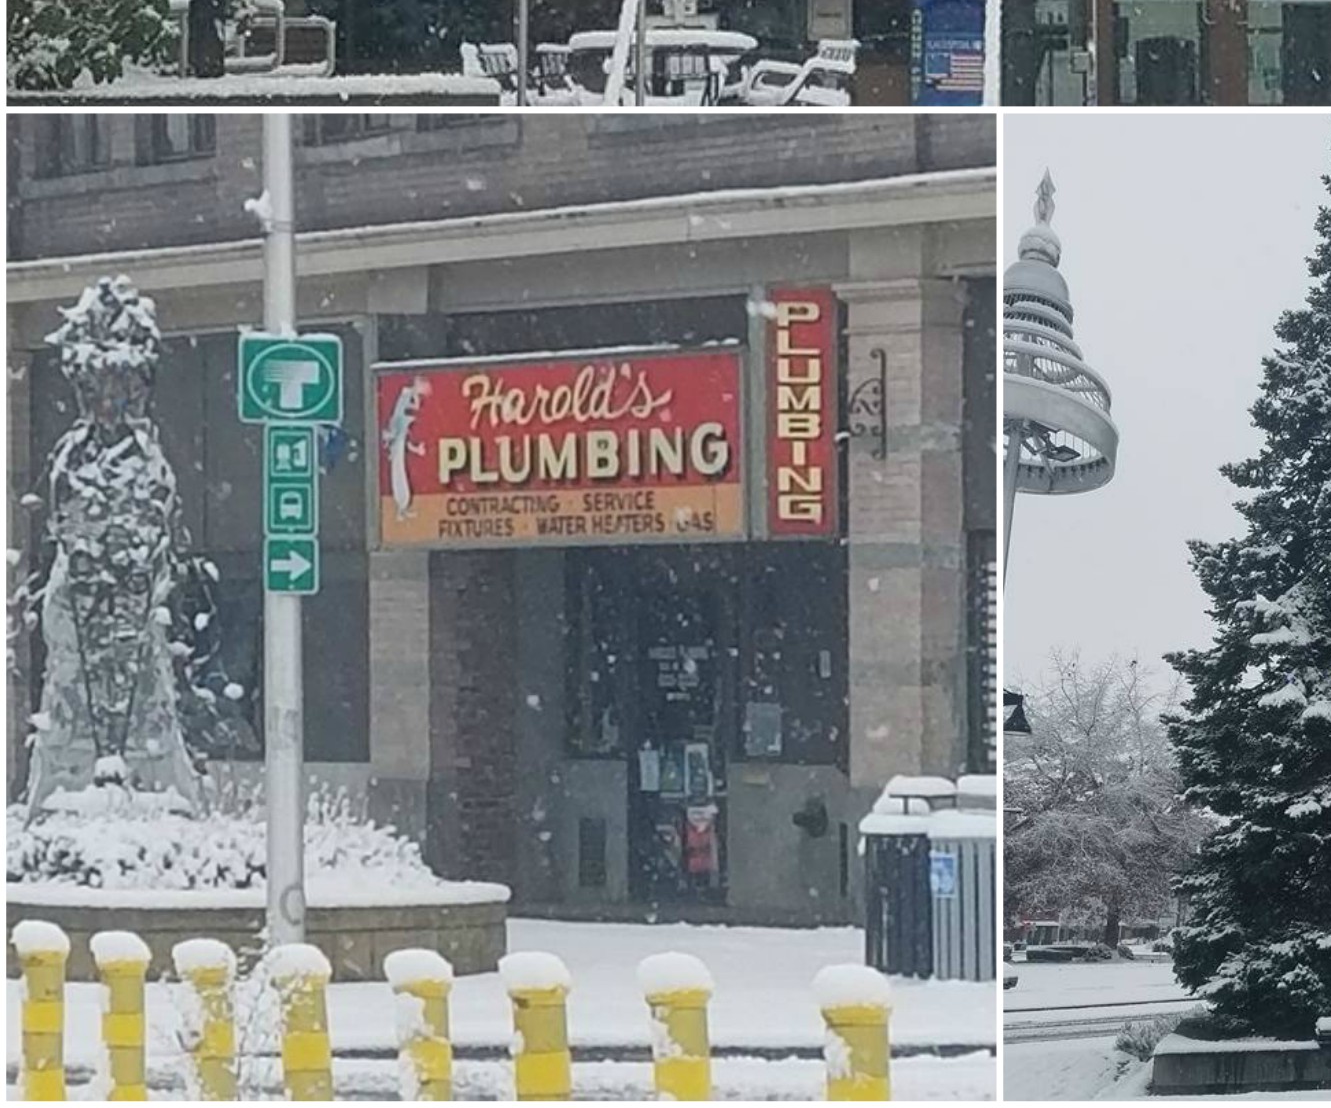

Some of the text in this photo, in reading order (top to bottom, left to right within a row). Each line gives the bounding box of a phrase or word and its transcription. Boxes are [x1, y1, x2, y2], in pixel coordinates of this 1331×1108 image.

[462, 364, 673, 430] Harold's
[777, 301, 822, 524] PLUMBING
[438, 422, 730, 485] PLUMBING
[438, 518, 515, 539] FIXTURES
[536, 513, 588, 536] WATER
[592, 511, 666, 535] HEATERS
[446, 491, 656, 517] CONTRACTING SERVICE
